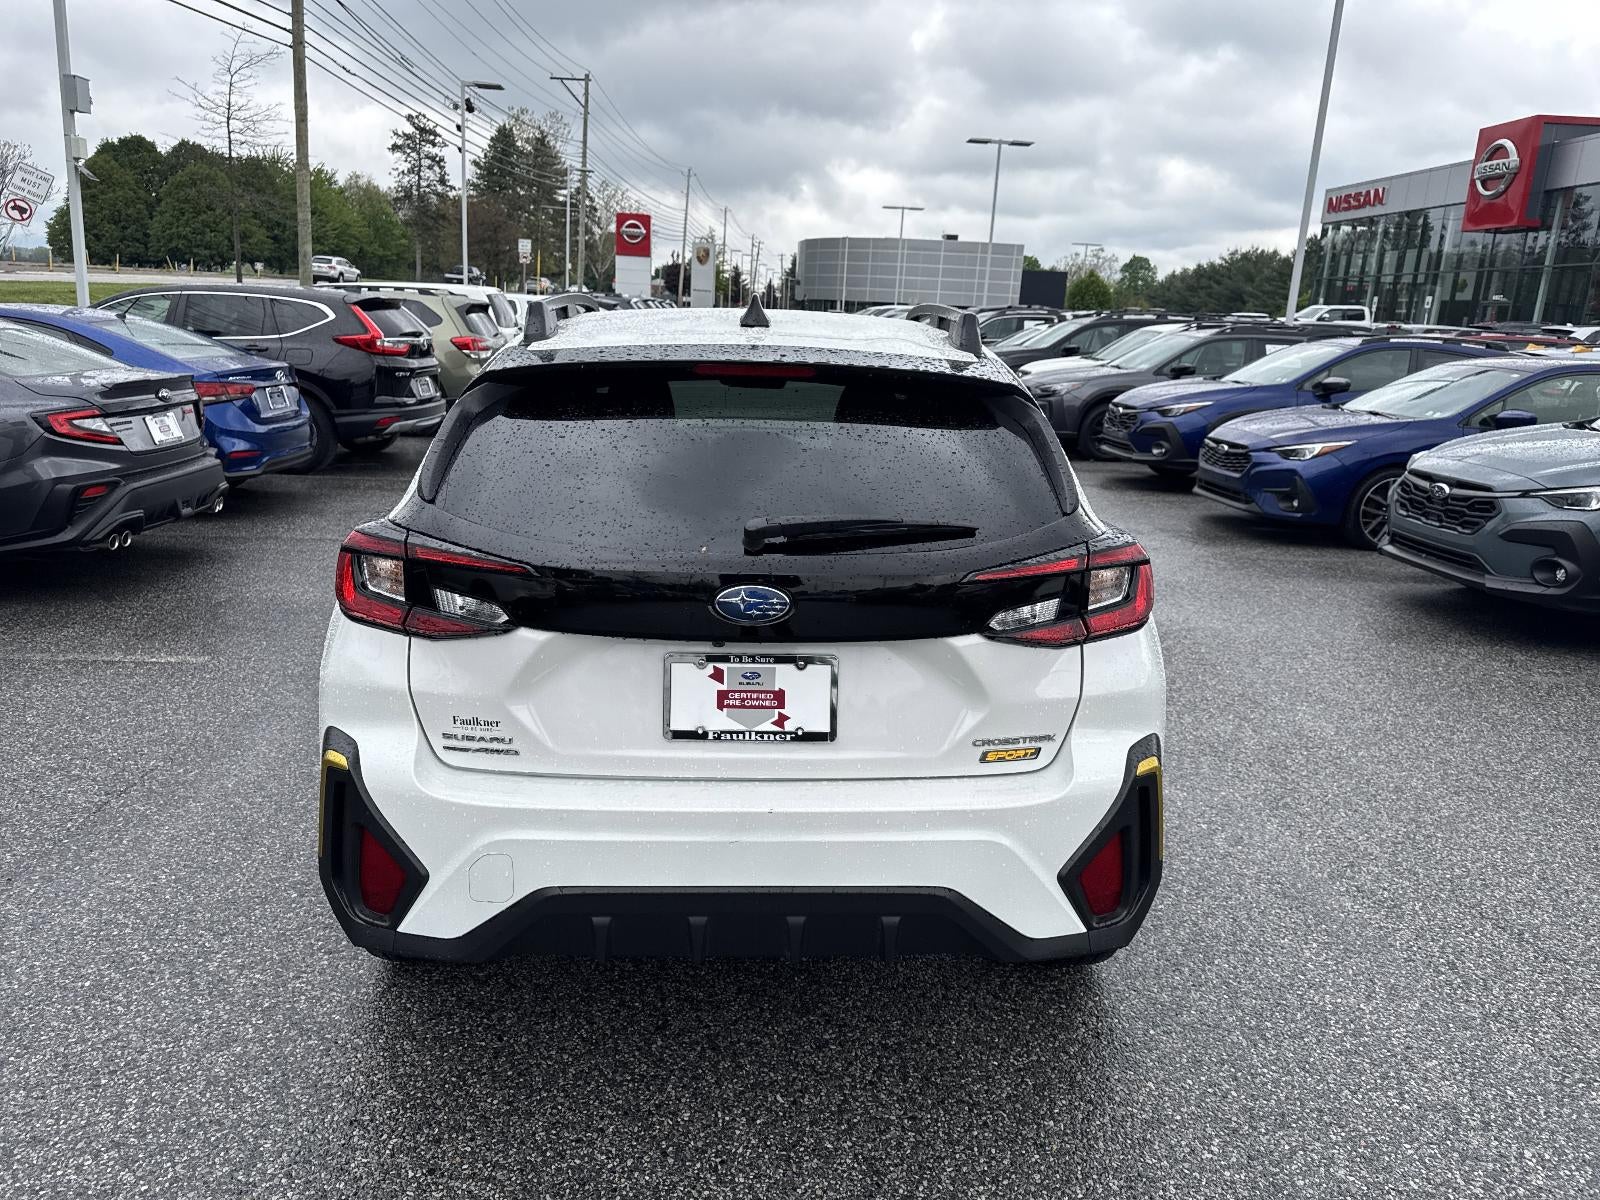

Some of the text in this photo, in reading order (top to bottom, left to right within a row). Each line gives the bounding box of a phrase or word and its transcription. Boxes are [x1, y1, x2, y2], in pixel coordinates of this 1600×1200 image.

[18, 165, 51, 184] RIGHT LANE
[1477, 161, 1511, 175] NISSAN
[20, 176, 42, 190] MUST
[10, 182, 44, 200] TURN RIGHT
[1327, 187, 1386, 214] NISSAN
[453, 715, 501, 727] Faulkner
[442, 732, 513, 744] SUBARU
[707, 731, 796, 741] Faulkner
[972, 733, 1056, 746] CROSSTREK
[985, 749, 1035, 761] SPORT
